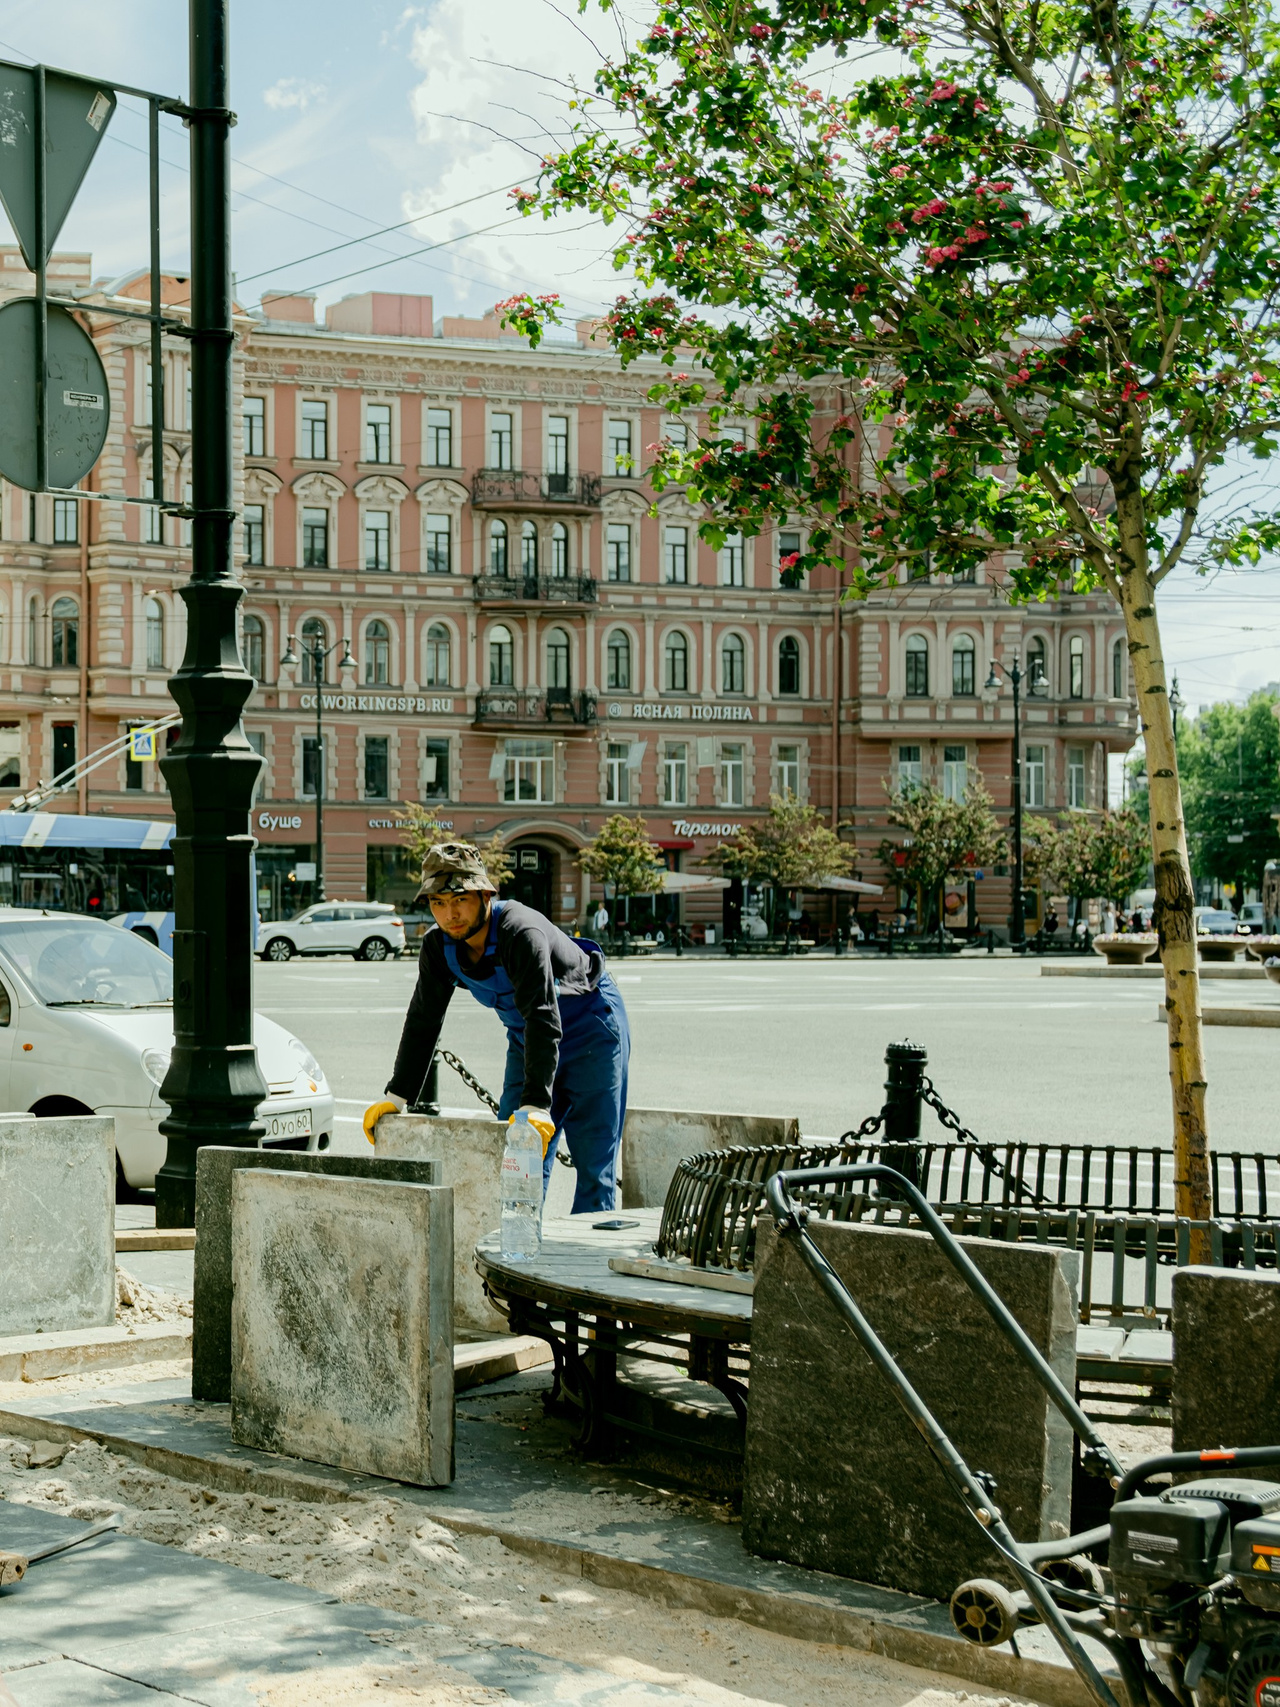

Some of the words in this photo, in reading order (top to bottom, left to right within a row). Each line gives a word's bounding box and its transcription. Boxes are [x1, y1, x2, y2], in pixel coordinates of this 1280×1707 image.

[300, 694, 451, 712] COWORKINGSPB.RU
[633, 703, 682, 718] ЯСНАЯ
[692, 704, 753, 720] ПОЛЯНА
[258, 811, 302, 831] буше
[369, 819, 393, 828] есть
[672, 820, 741, 837] Теремок
